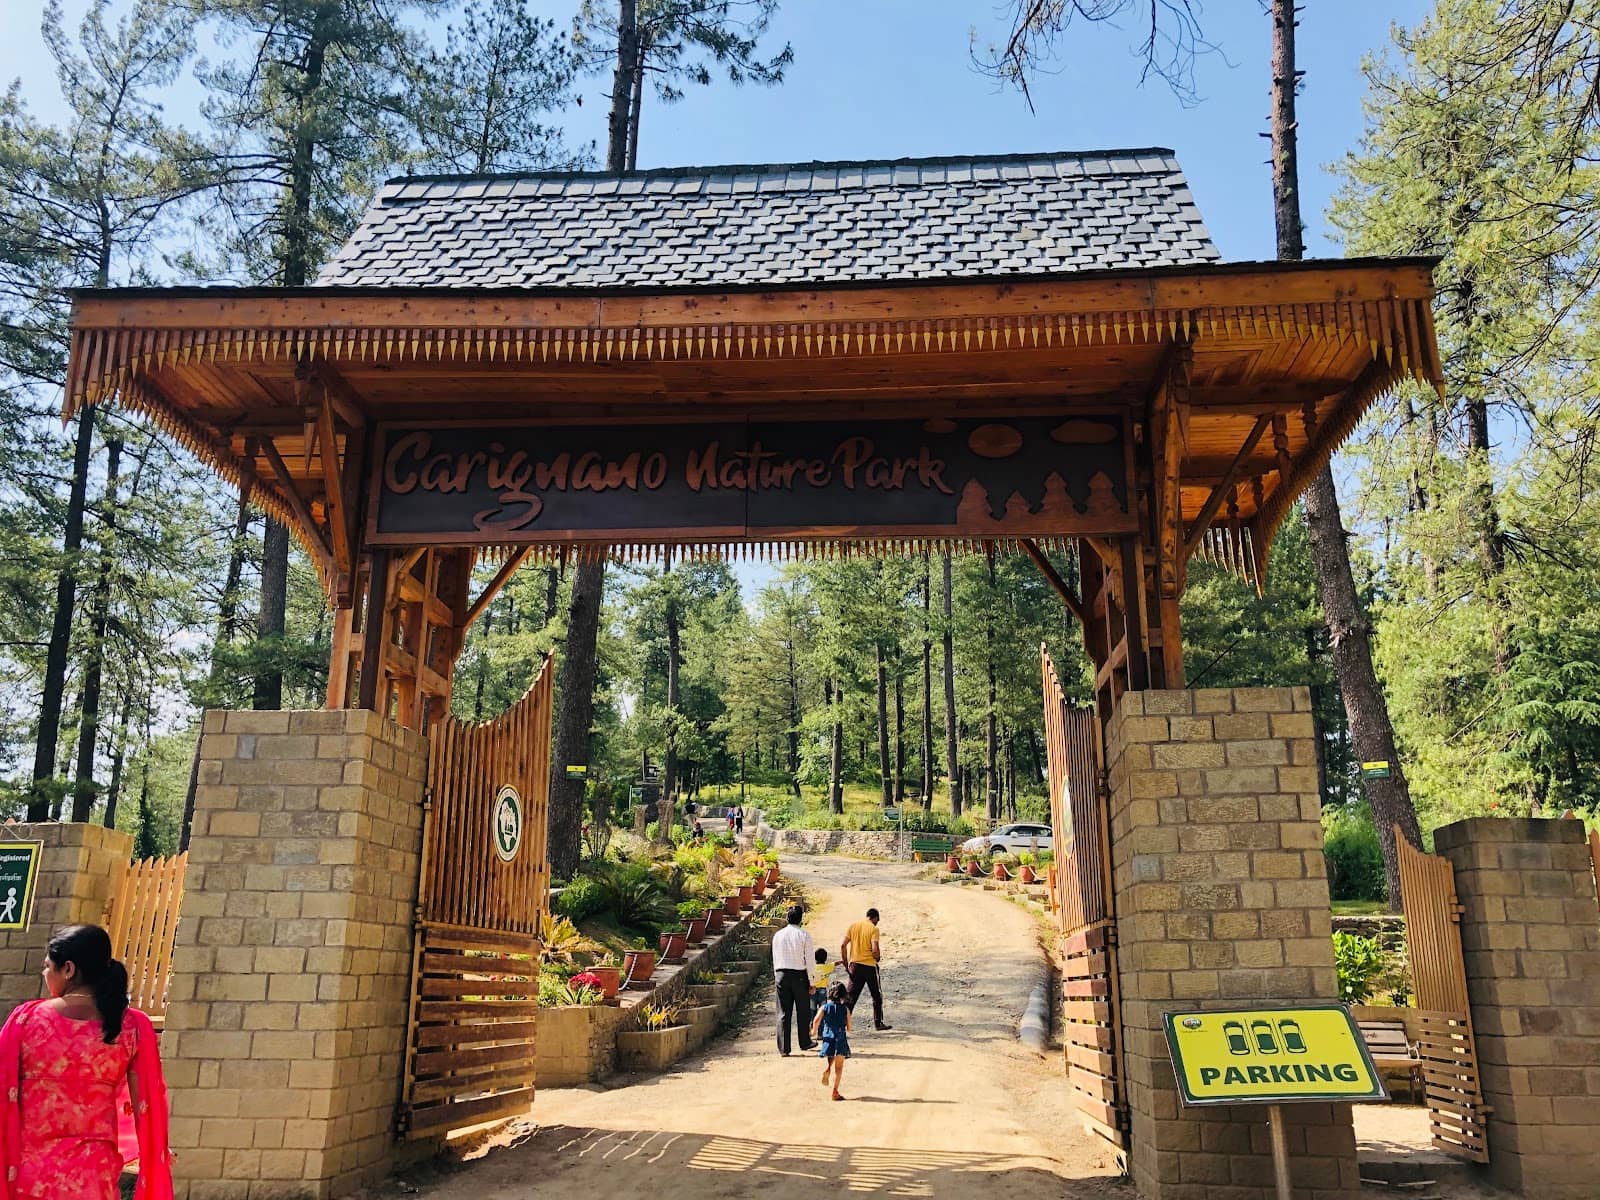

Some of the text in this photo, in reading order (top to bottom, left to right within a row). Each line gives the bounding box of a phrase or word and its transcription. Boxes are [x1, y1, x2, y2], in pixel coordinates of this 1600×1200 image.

[384, 431, 956, 532] Carignano Nature Park
[1199, 1063, 1359, 1085] PARKING
